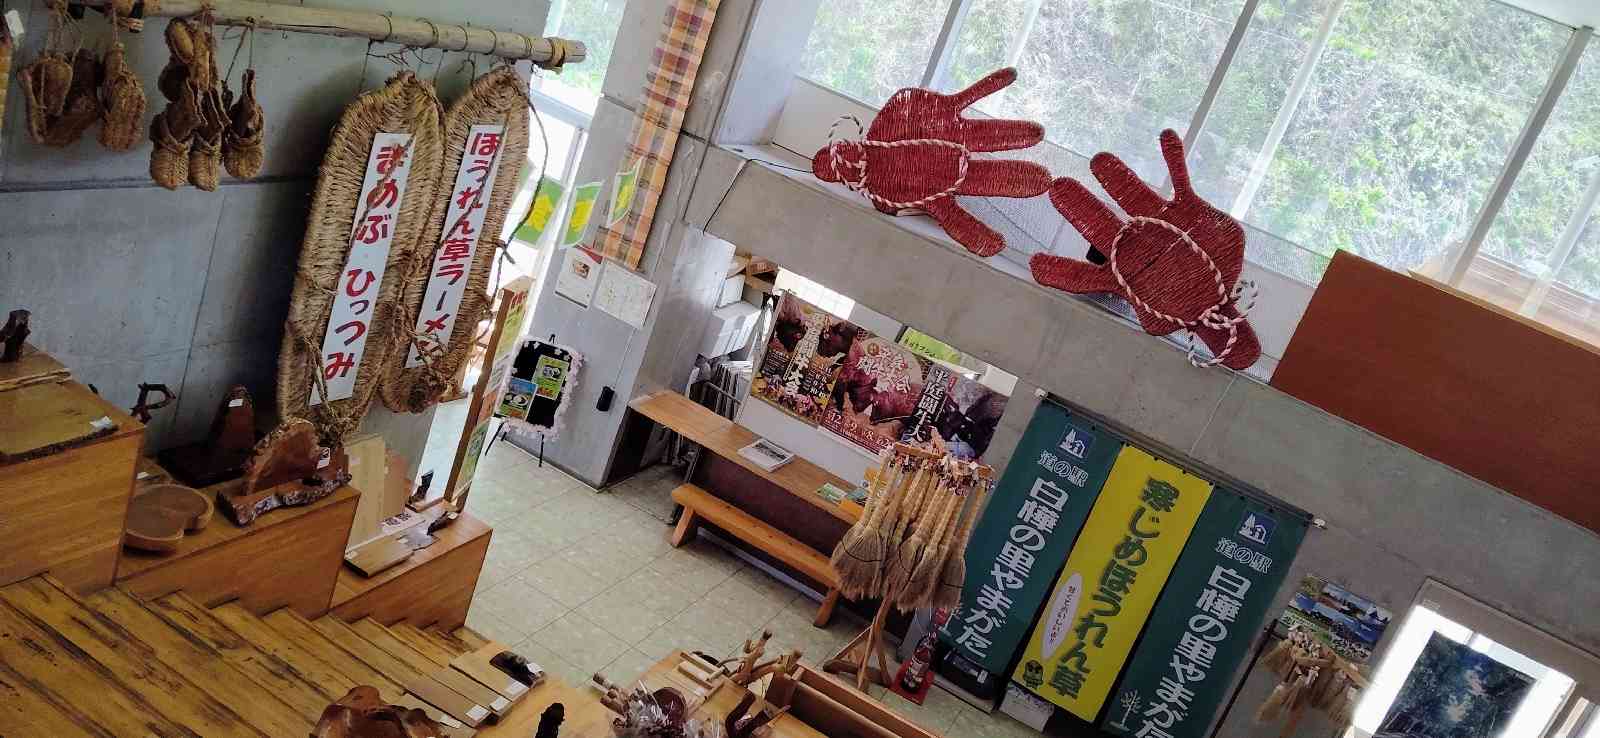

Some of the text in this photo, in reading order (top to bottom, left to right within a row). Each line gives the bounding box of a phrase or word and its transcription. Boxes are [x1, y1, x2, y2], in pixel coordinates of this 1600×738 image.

[324, 268, 376, 381] ひっつみ
[1037, 450, 1090, 488] 道の駅
[955, 477, 1070, 659] 白樺の里やまがた
[1049, 477, 1180, 699] 寒じめほうれん草
[1215, 535, 1274, 574] 道の駅
